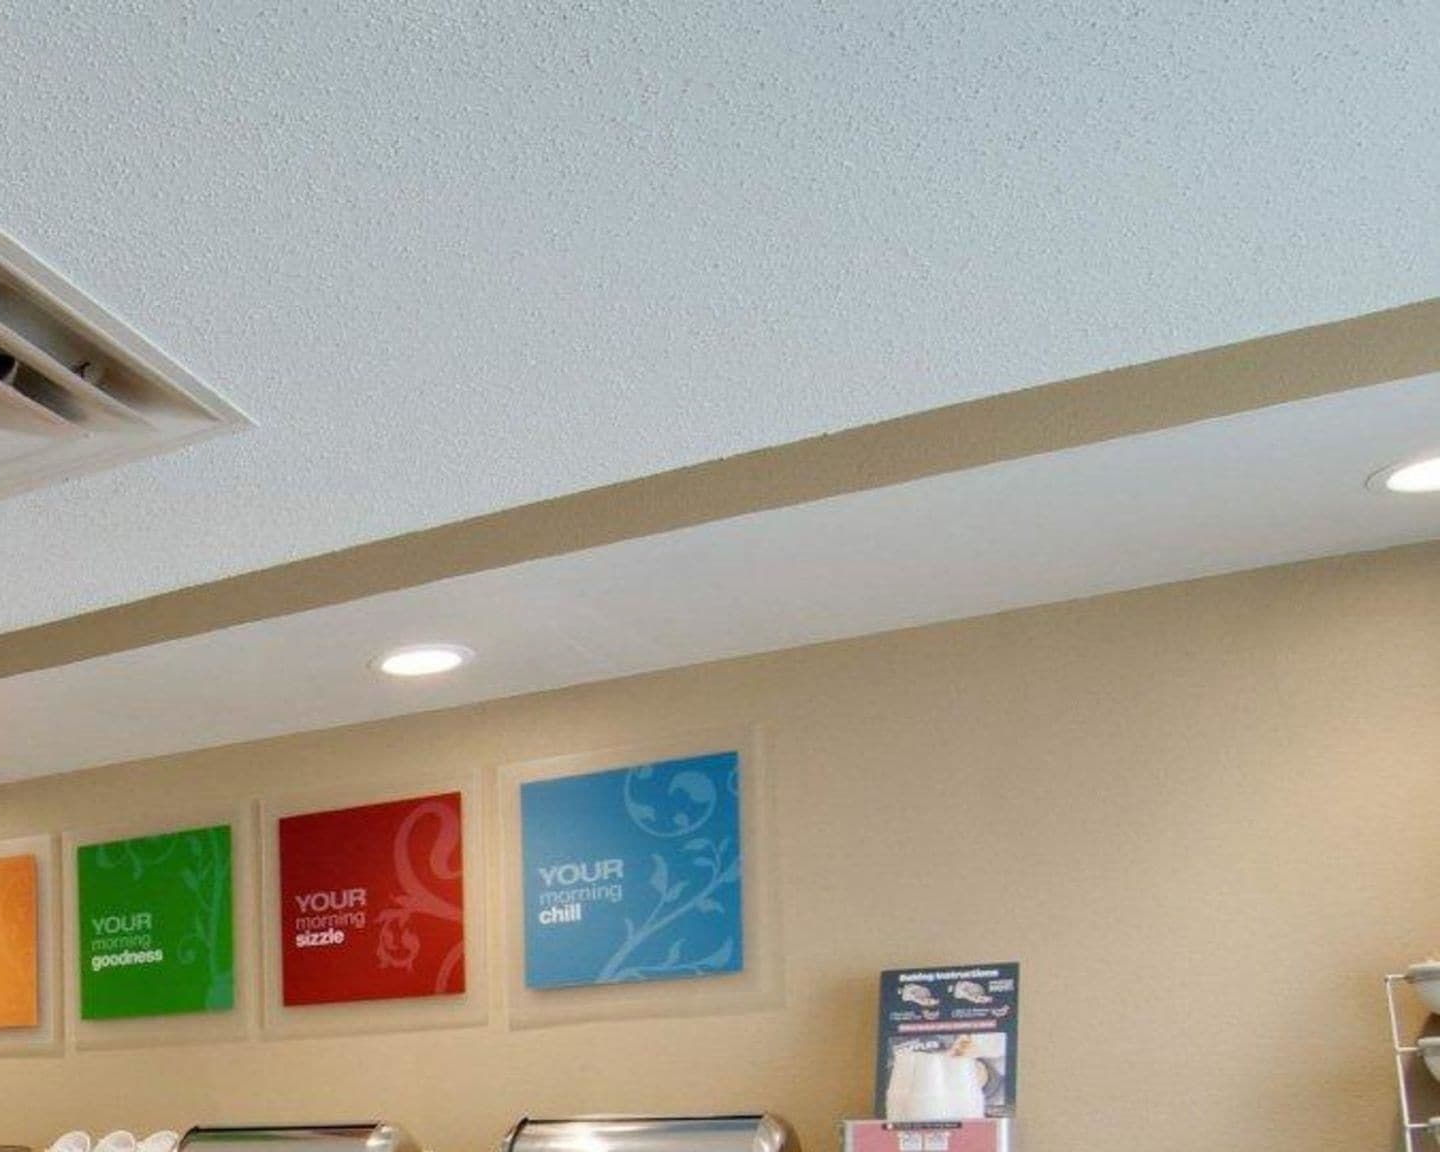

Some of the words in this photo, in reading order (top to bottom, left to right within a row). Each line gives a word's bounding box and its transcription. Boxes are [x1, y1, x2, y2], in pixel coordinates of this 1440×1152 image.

[538, 859, 624, 887] YOUR
[295, 888, 366, 912] YOUR
[539, 884, 623, 905] morning
[91, 912, 153, 935] YOUR
[296, 911, 366, 929] morning
[539, 902, 582, 925] chill
[92, 934, 151, 950] morning
[296, 927, 345, 948] sizzle
[91, 949, 163, 971] goodness
